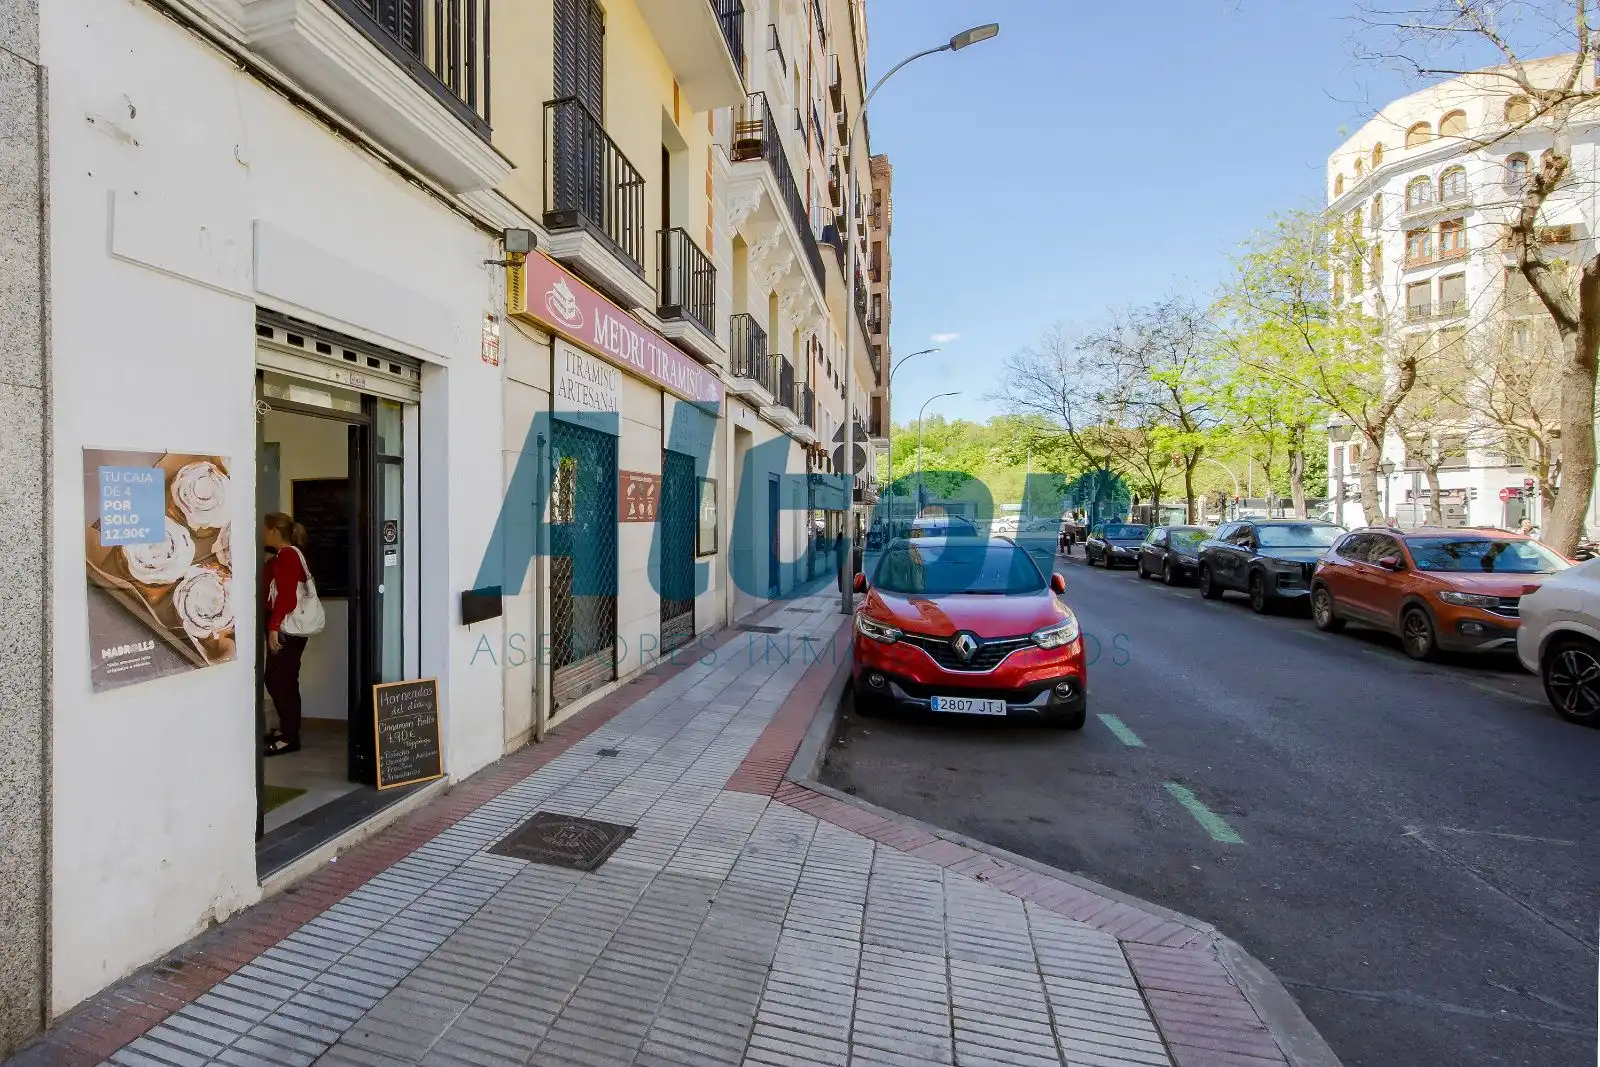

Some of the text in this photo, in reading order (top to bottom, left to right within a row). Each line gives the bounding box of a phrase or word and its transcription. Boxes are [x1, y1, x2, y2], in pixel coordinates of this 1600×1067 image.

[593, 307, 645, 369] MEDRI
[103, 471, 153, 484] TU CAJA
[103, 486, 132, 497] DE 4
[103, 500, 132, 511] POR
[103, 514, 139, 526] SOLO
[940, 698, 1003, 713] 2807 JTJ
